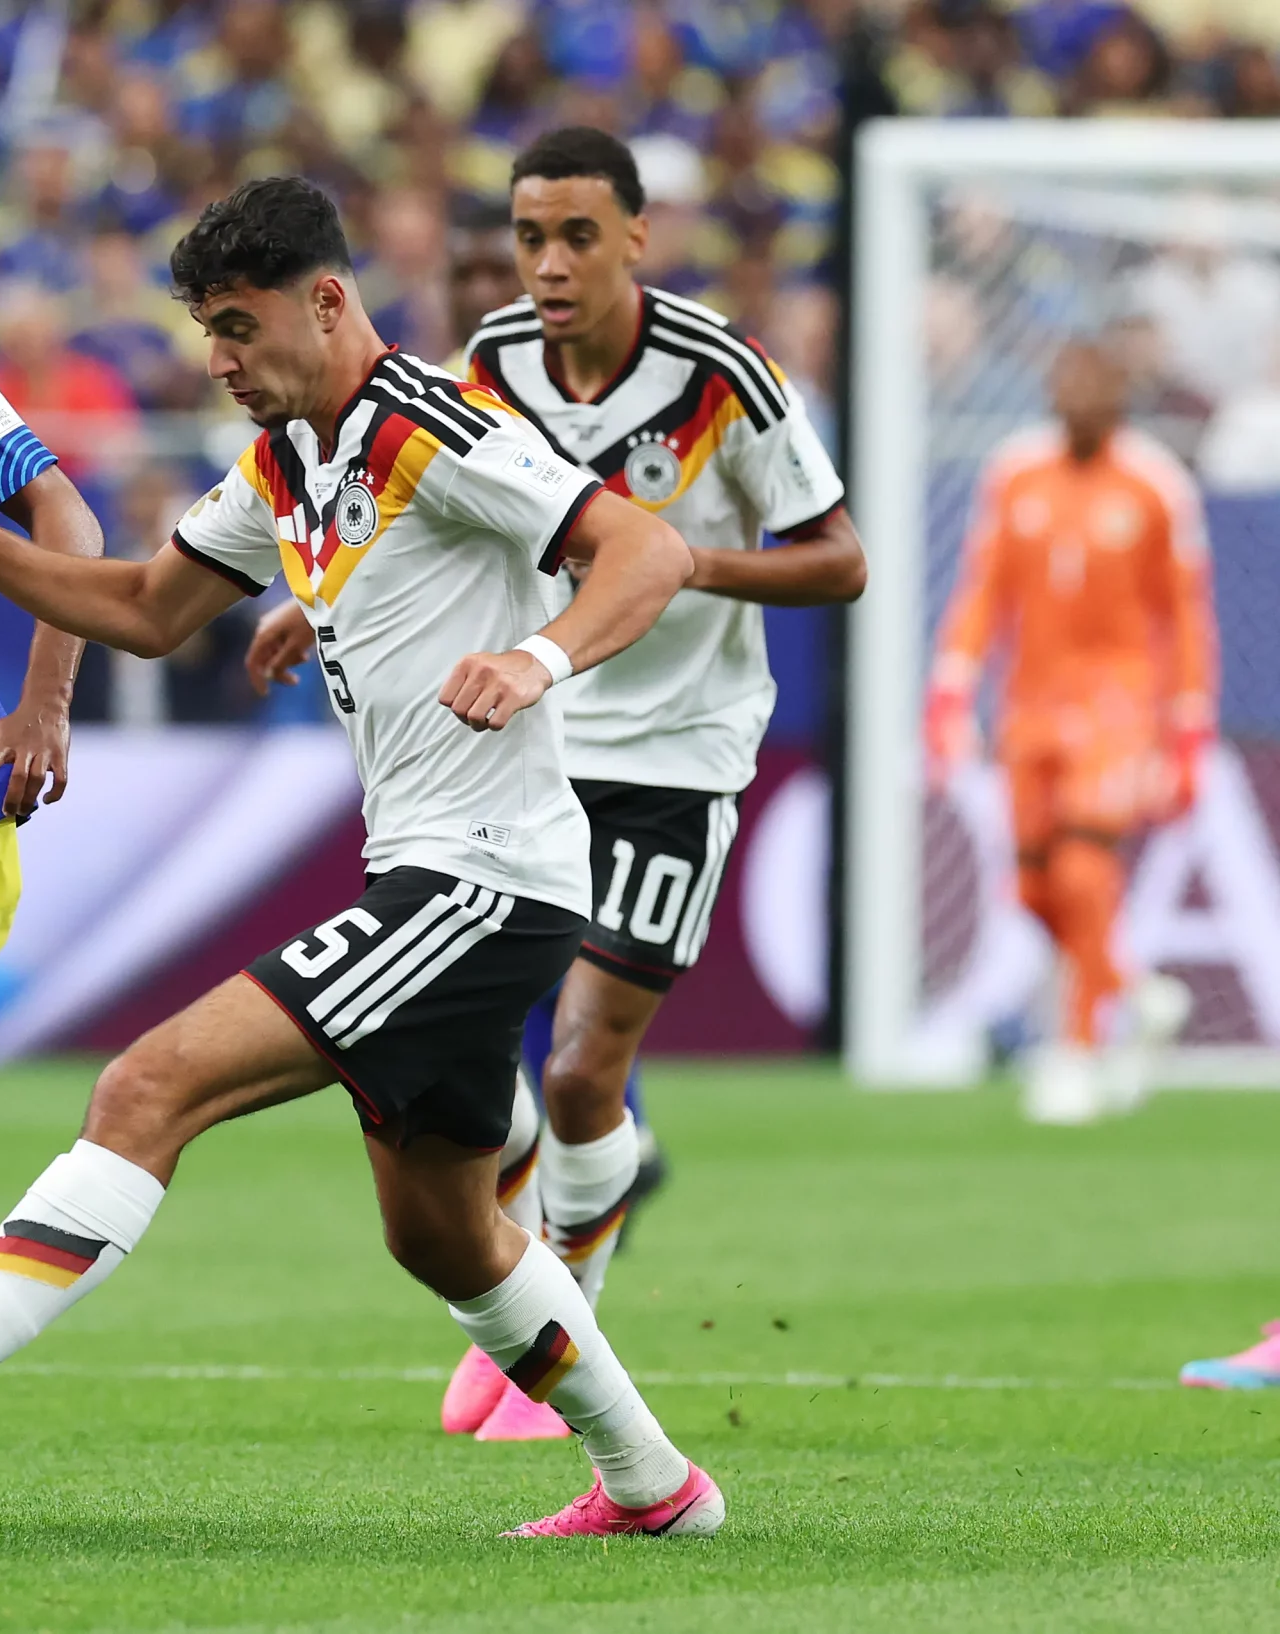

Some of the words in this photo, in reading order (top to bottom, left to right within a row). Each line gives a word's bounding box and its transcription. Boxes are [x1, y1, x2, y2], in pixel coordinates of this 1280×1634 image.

[317, 626, 357, 714] 5
[597, 838, 694, 945] 10
[280, 907, 383, 979] 5
